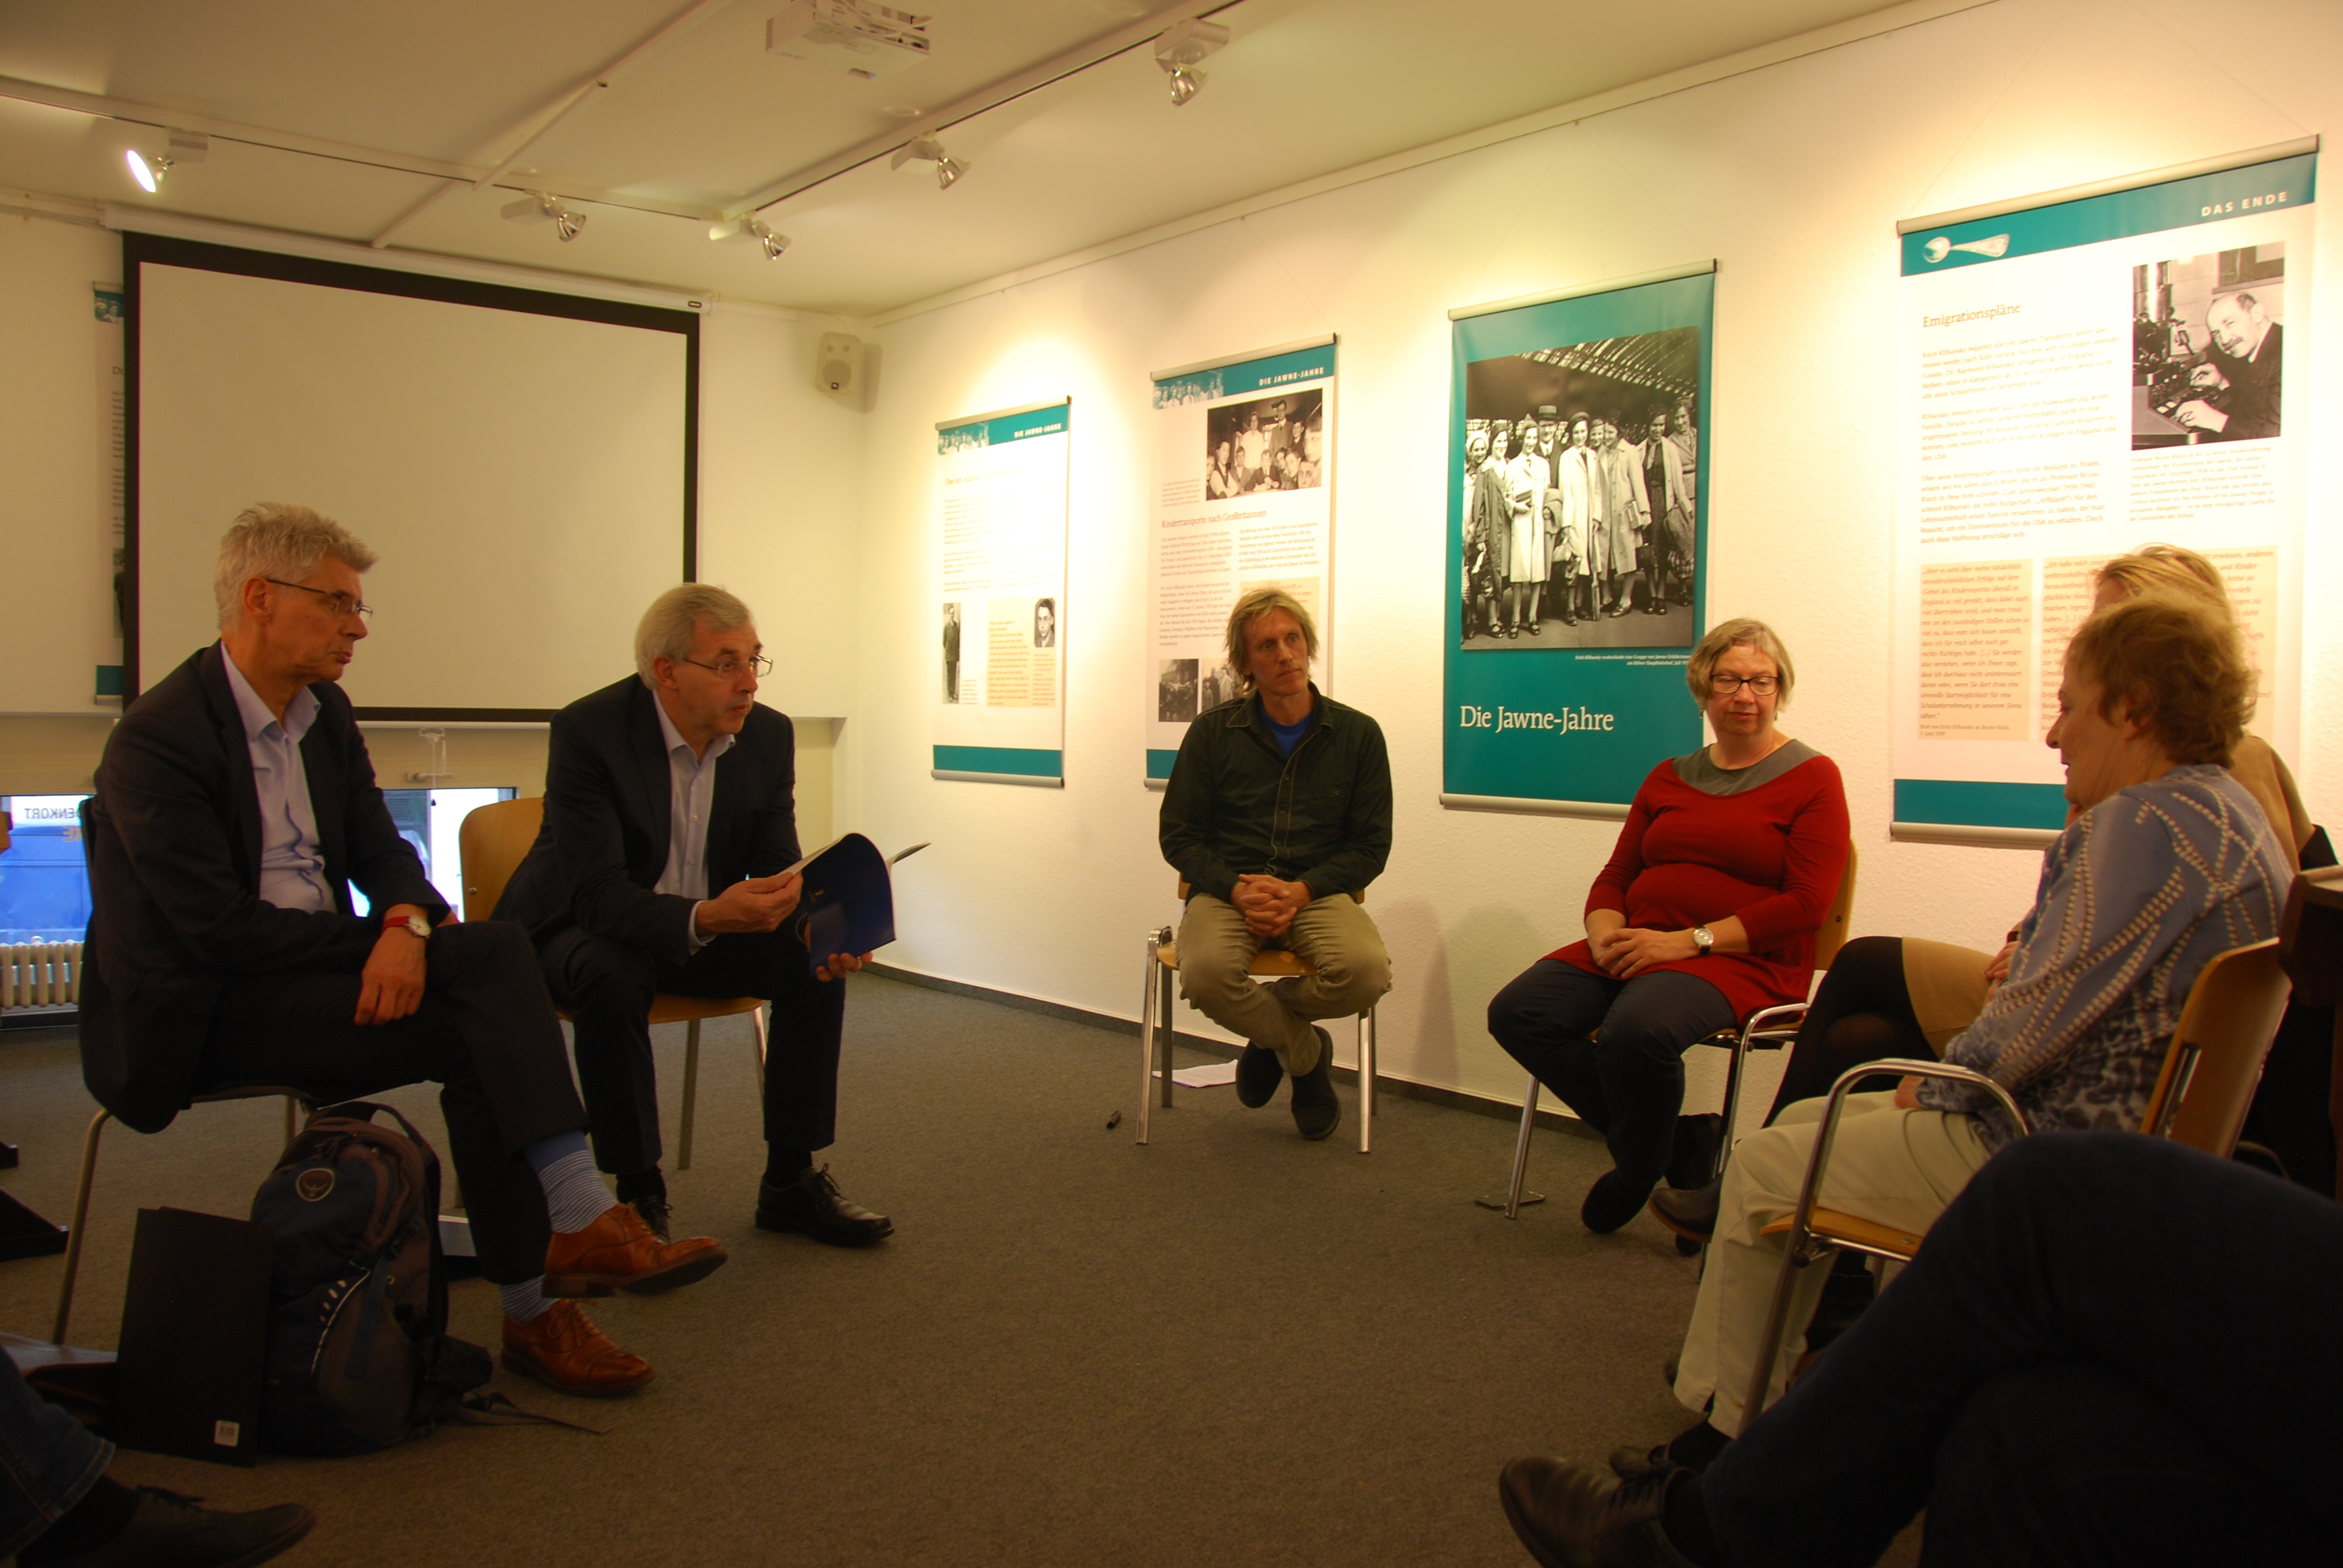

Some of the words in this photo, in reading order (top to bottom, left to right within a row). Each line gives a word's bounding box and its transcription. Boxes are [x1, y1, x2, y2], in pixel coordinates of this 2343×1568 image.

[2201, 201, 2234, 217] DAS
[2241, 191, 2287, 209] ENDE
[1923, 304, 2021, 327] Emigrationspläne
[1259, 377, 1271, 386] DIE
[1273, 367, 1324, 384] JAWNE-JAHRE
[1460, 705, 1492, 728] Die
[1495, 706, 1614, 735] Jawne-Jahre
